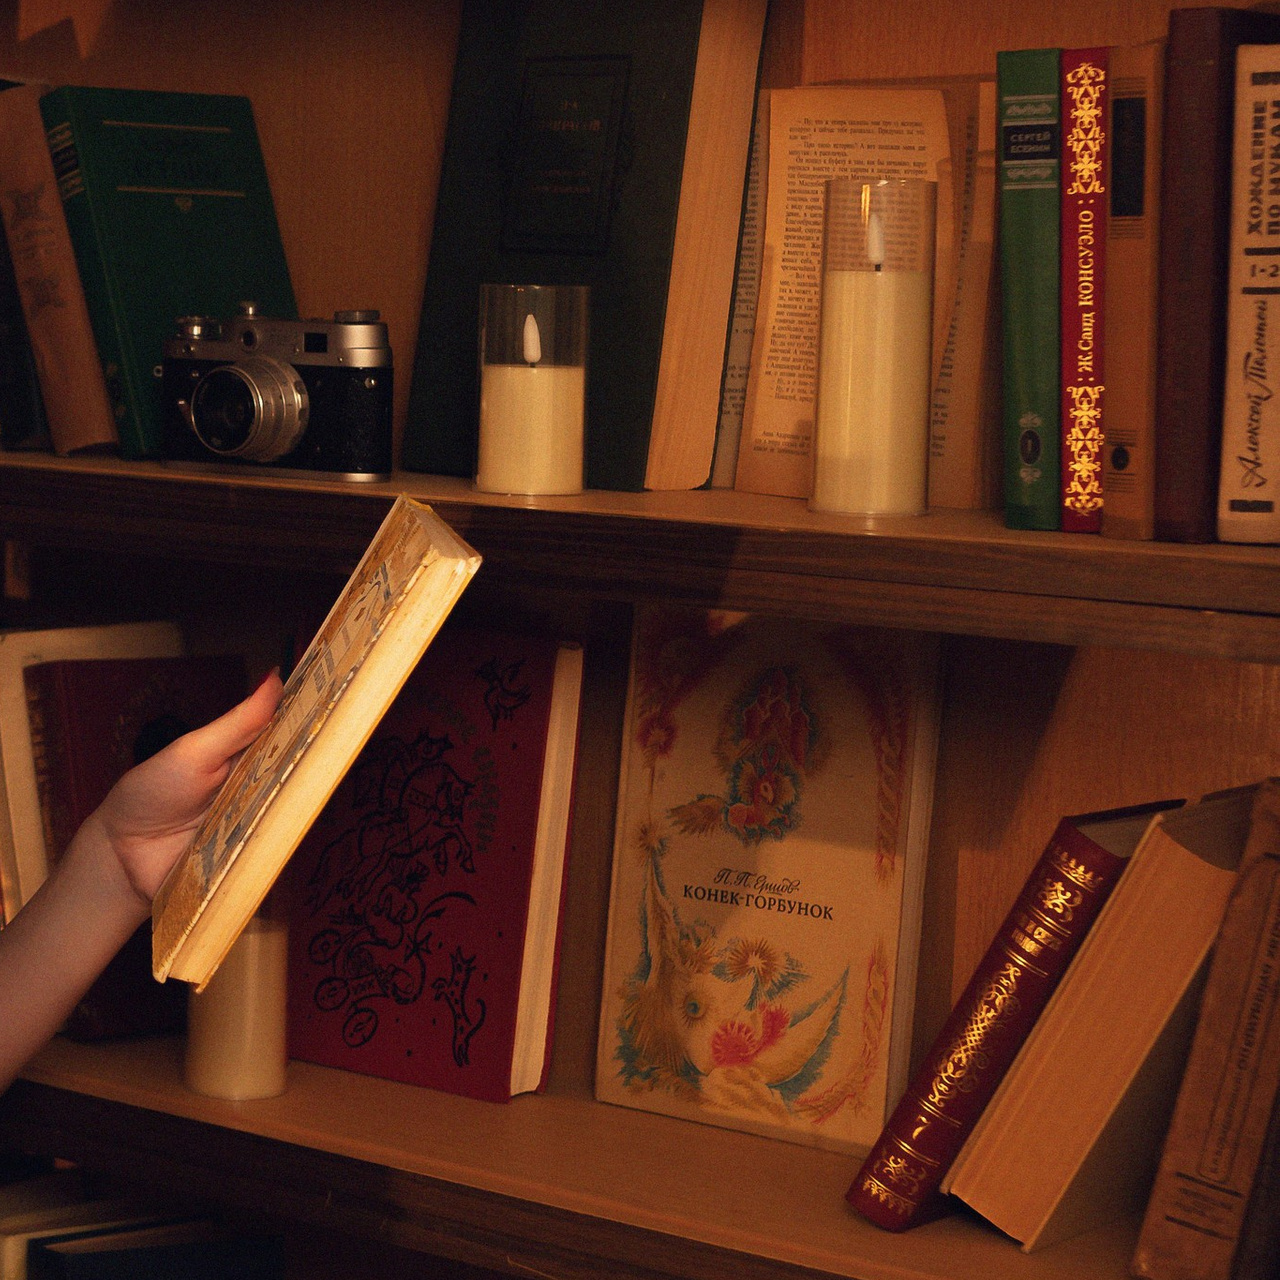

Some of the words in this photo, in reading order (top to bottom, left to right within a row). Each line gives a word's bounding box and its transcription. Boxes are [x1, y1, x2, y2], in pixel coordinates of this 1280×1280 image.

[1246, 99, 1267, 236] ХОЖДЕНИЕ
[1077, 208, 1095, 307] КОНСУЭЛО
[683, 884, 834, 922] КОНЕК-ГОРБУНОК
[754, 873, 802, 895] Ершов
[911, 1114, 929, 1140] 7
